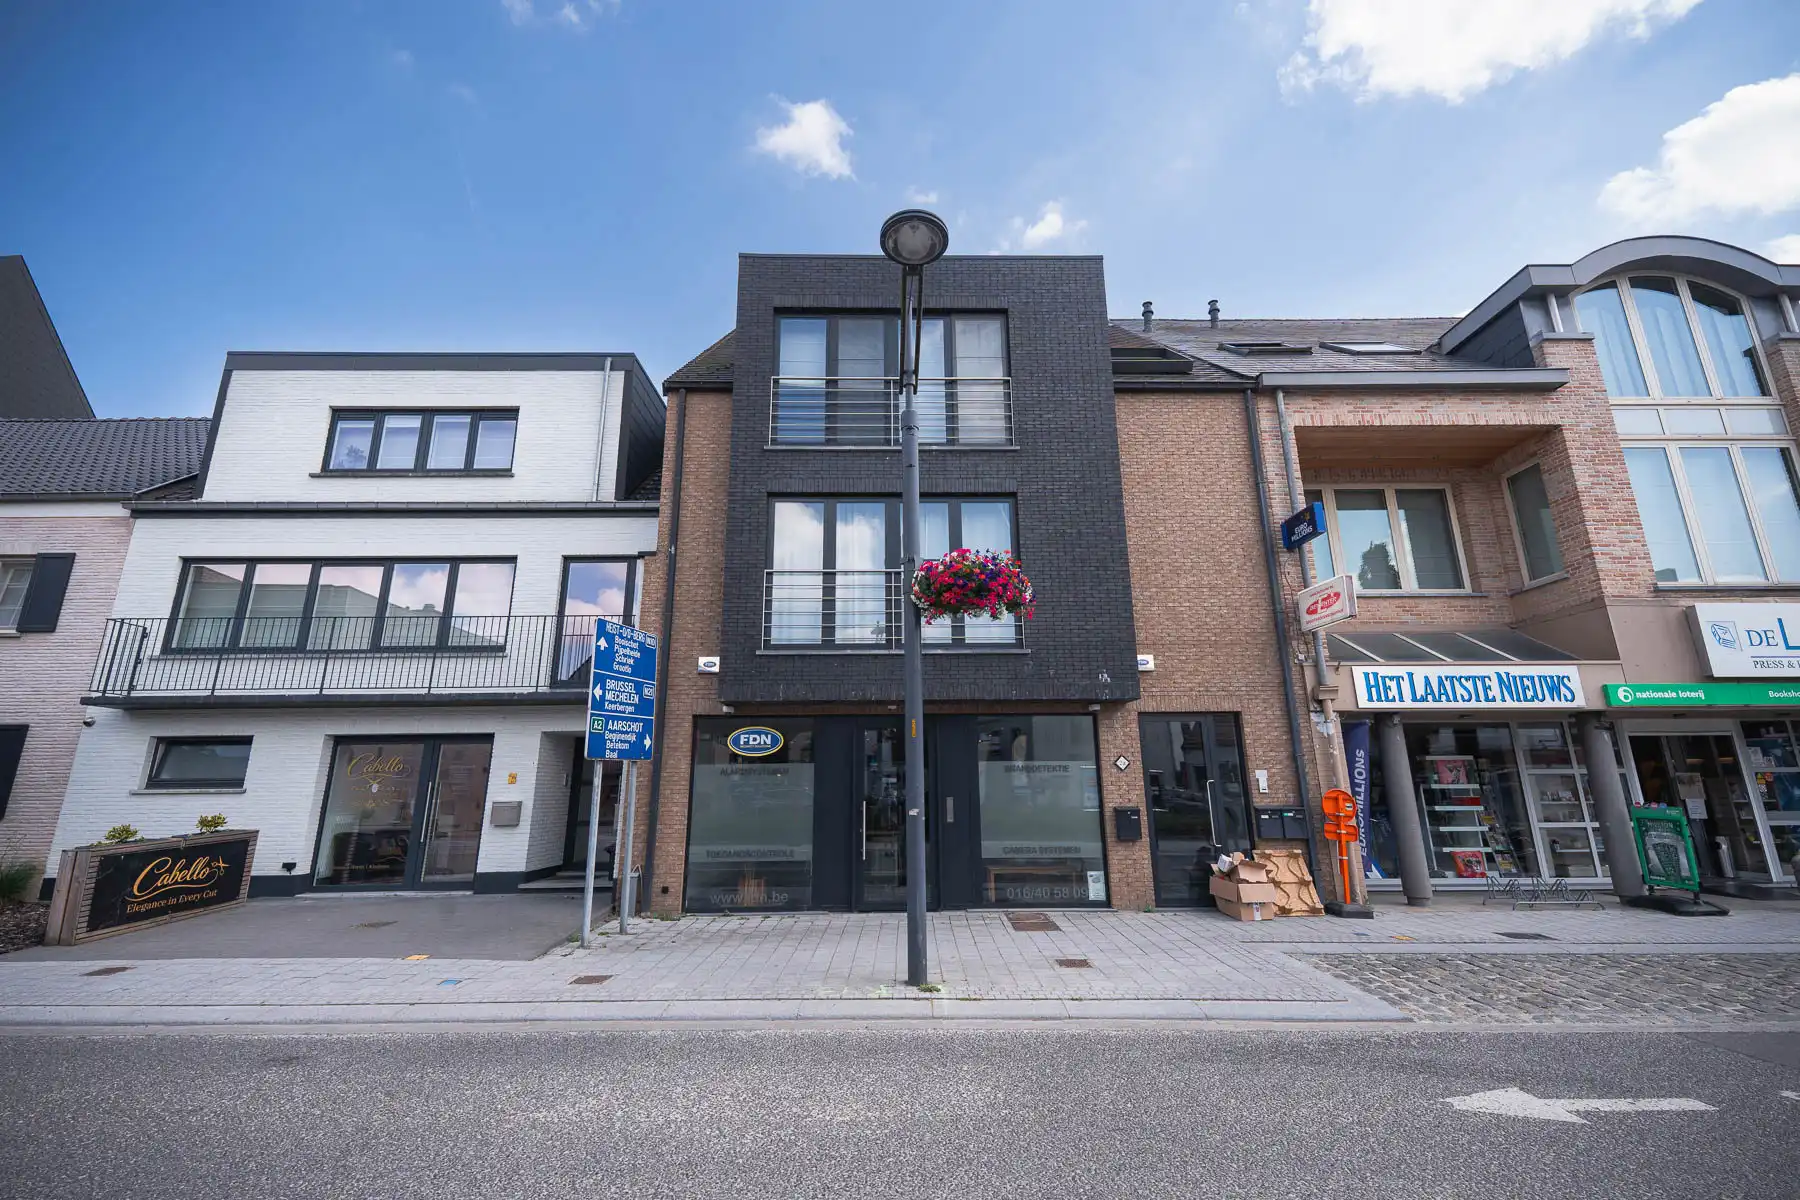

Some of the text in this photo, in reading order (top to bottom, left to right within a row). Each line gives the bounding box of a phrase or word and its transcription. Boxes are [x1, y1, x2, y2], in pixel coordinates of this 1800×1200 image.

[1291, 525, 1313, 542] MILLIONS
[1294, 522, 1307, 534] EURO
[1744, 629, 1779, 647] DE
[615, 653, 635, 665] Schriek
[1753, 660, 1785, 669] PRESS
[1787, 660, 1796, 669] &
[606, 679, 636, 693] BRUSSEL
[1362, 671, 1576, 703] HET LAATSTE NIEUWS
[605, 690, 639, 704] MECHELEN
[1636, 690, 1705, 700] nationale loterij
[604, 701, 635, 713] Keerbergen
[593, 720, 643, 733] A2 AARSCHOT
[606, 740, 629, 750] Betekom
[739, 734, 772, 745] FDN
[606, 750, 618, 759] Baal
[348, 752, 406, 777] Cabello
[130, 856, 214, 897] Cabello
[1006, 886, 1050, 899] 016/40
[1053, 886, 1069, 899] 58
[126, 889, 218, 913] Elegance in Every Cut
